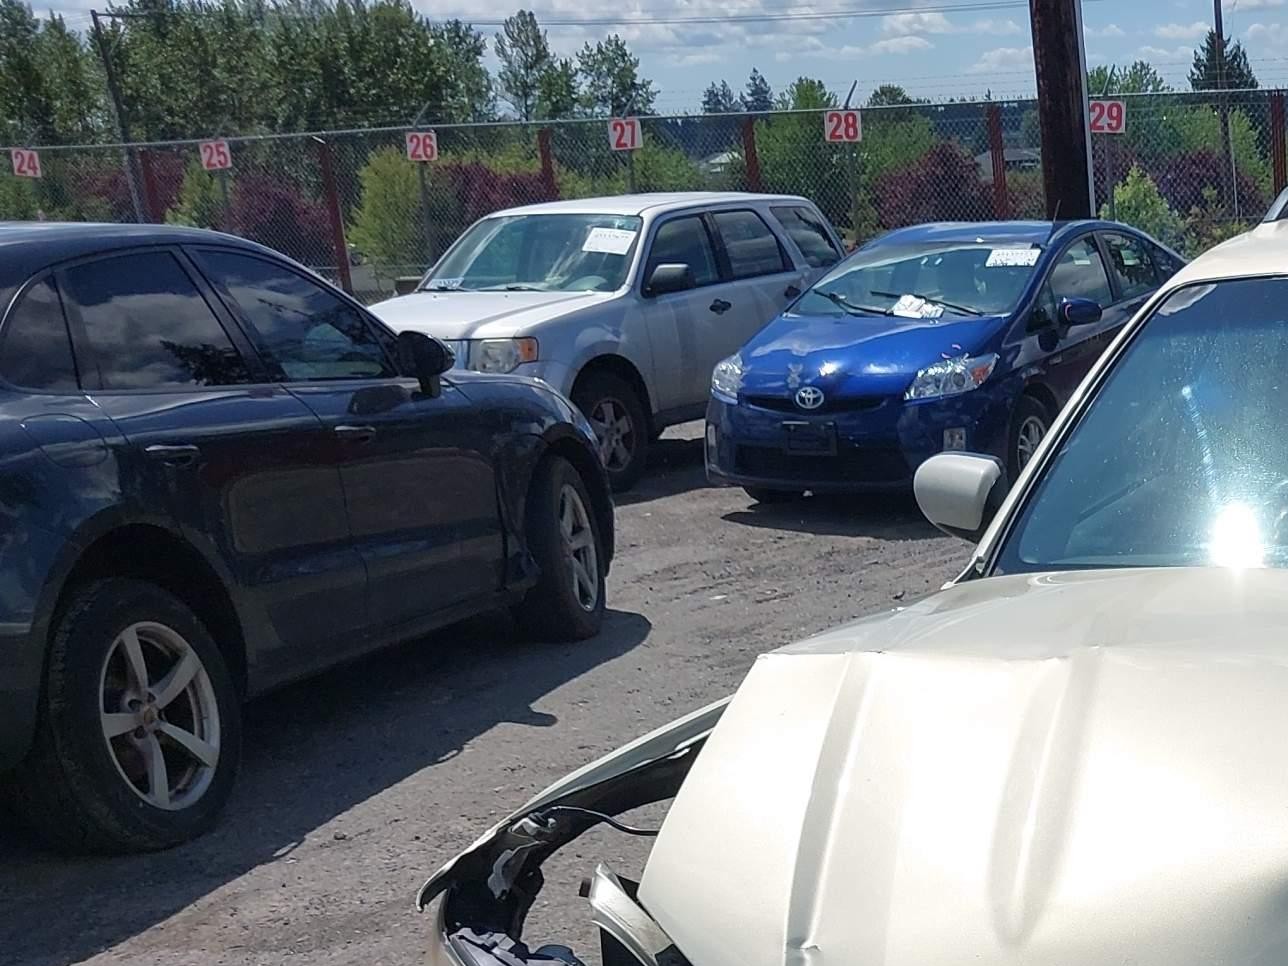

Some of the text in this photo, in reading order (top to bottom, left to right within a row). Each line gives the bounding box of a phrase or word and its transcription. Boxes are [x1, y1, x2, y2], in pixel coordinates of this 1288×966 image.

[828, 112, 858, 140] 28
[1090, 102, 1123, 131] 29
[409, 135, 434, 159] 26
[613, 121, 636, 148] 27
[14, 150, 39, 175] 24
[203, 141, 228, 168] 25
